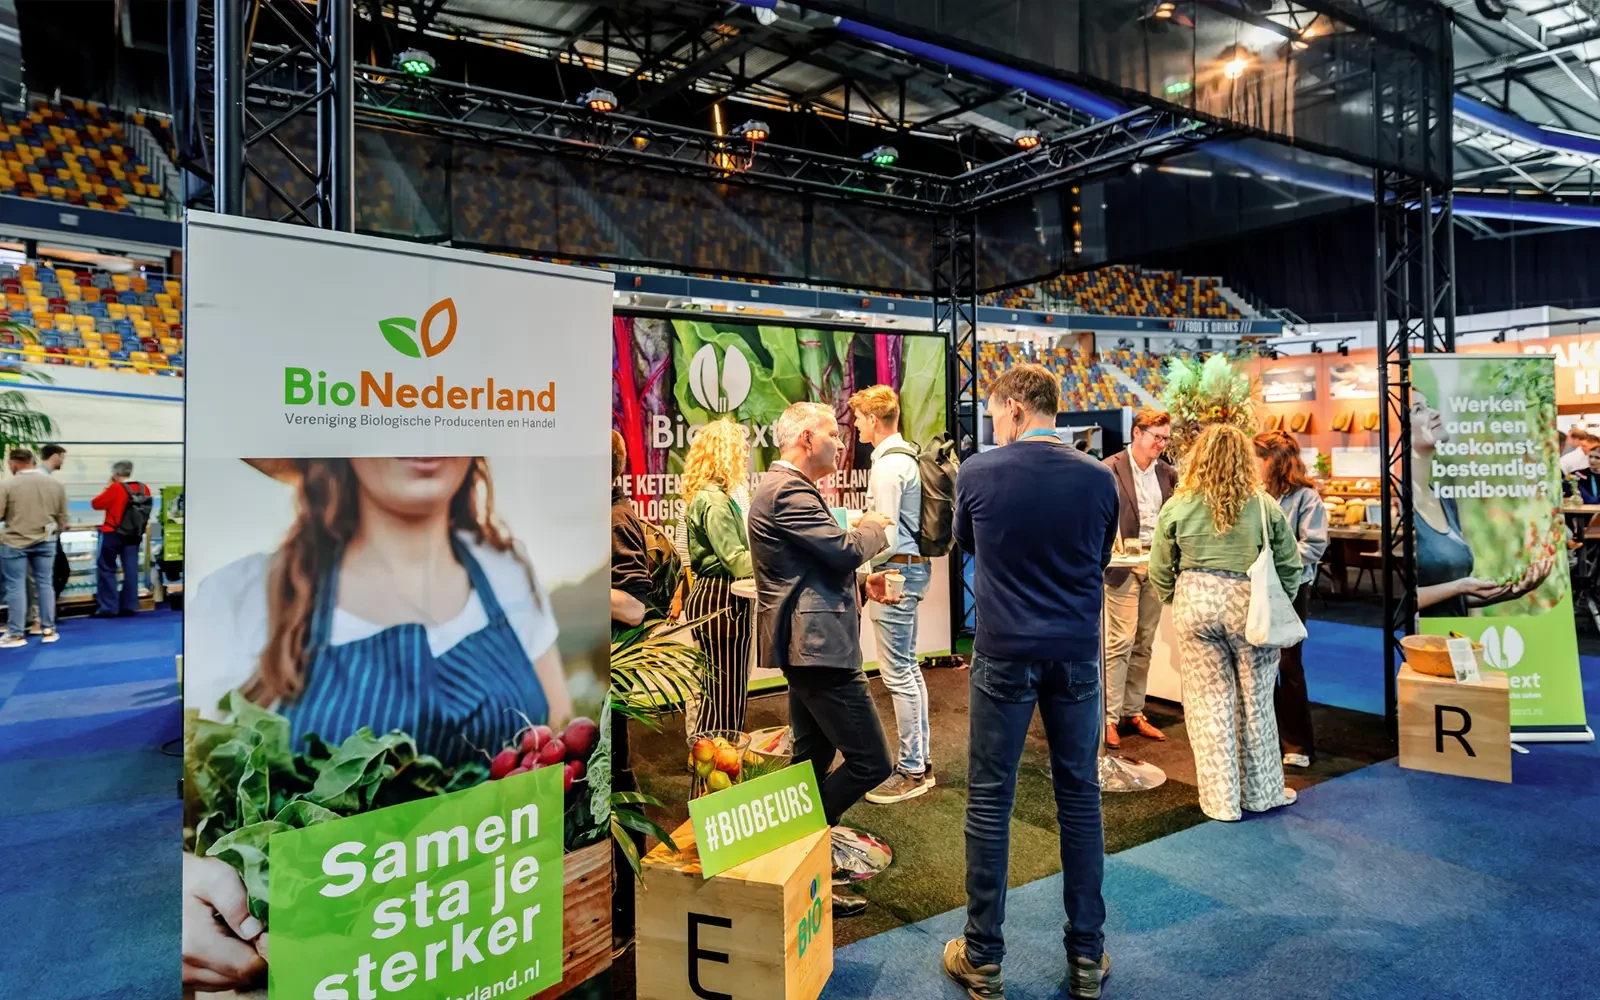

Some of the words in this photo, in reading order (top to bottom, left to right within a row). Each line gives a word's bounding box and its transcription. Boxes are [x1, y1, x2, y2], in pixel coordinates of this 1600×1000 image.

[1184, 321, 1202, 332] FOOD
[1211, 322, 1239, 333] DRINKS
[284, 366, 556, 412] BioNederland
[1448, 396, 1526, 413] Werken
[284, 412, 357, 429] Vereniging
[360, 414, 431, 429] Biologische
[434, 416, 505, 428] Producenten
[507, 419, 520, 428] en
[522, 417, 556, 428] Handel
[1446, 419, 1484, 434] aan
[1490, 419, 1528, 434] een
[1431, 458, 1547, 479] bestendige
[1434, 437, 1542, 455] toekomst-
[1434, 480, 1548, 499] landbouw?
[1434, 703, 1477, 757] R
[705, 782, 814, 852] #BIOBEURS
[318, 803, 539, 898] Samen
[371, 880, 470, 940] sta
[491, 854, 540, 916] je
[797, 896, 822, 959] BIO
[313, 903, 541, 1000] sterker
[687, 911, 733, 1000] E
